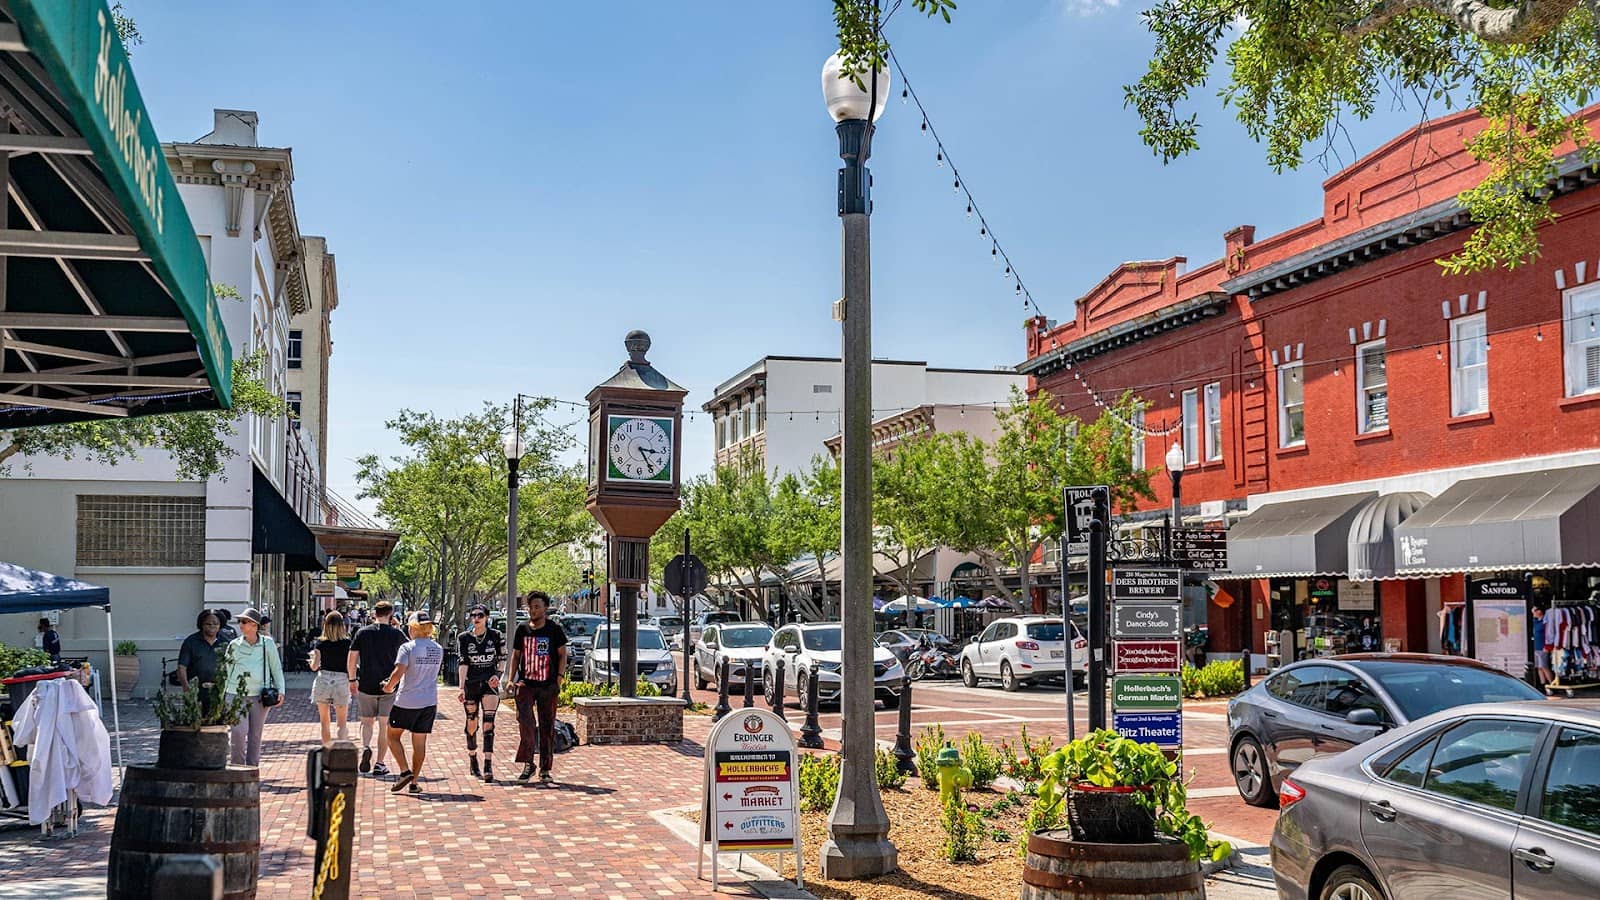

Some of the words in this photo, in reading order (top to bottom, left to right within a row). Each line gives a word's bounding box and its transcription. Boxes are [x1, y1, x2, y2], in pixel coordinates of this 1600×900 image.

[626, 424, 632, 432] 11
[637, 422, 645, 431] 12
[651, 425, 654, 434] 1
[617, 433, 626, 441] 10
[658, 434, 664, 442] 2
[613, 444, 620, 452] 9
[660, 446, 667, 454] 3
[617, 456, 623, 464] 8
[656, 457, 663, 466] 4
[626, 463, 632, 472] 7
[636, 467, 642, 475] 6
[1185, 541, 1197, 549] Zoo
[1200, 551, 1214, 559] Court
[1193, 560, 1204, 569] City
[1204, 560, 1215, 568] Hall
[1116, 578, 1136, 586] DEES
[1137, 578, 1179, 586] BROTHERS
[1129, 586, 1166, 594] BREWERY
[1136, 610, 1159, 621] Cindy's
[1126, 620, 1146, 628] Dance
[1147, 620, 1169, 628] Studio
[1124, 684, 1171, 692] Hollerbach's
[1119, 727, 1138, 738] Ritz
[1138, 726, 1176, 737] Theater
[734, 733, 775, 742] ERDINGER
[740, 797, 783, 807] MARKET
[741, 819, 786, 831] OUTFITTERS
